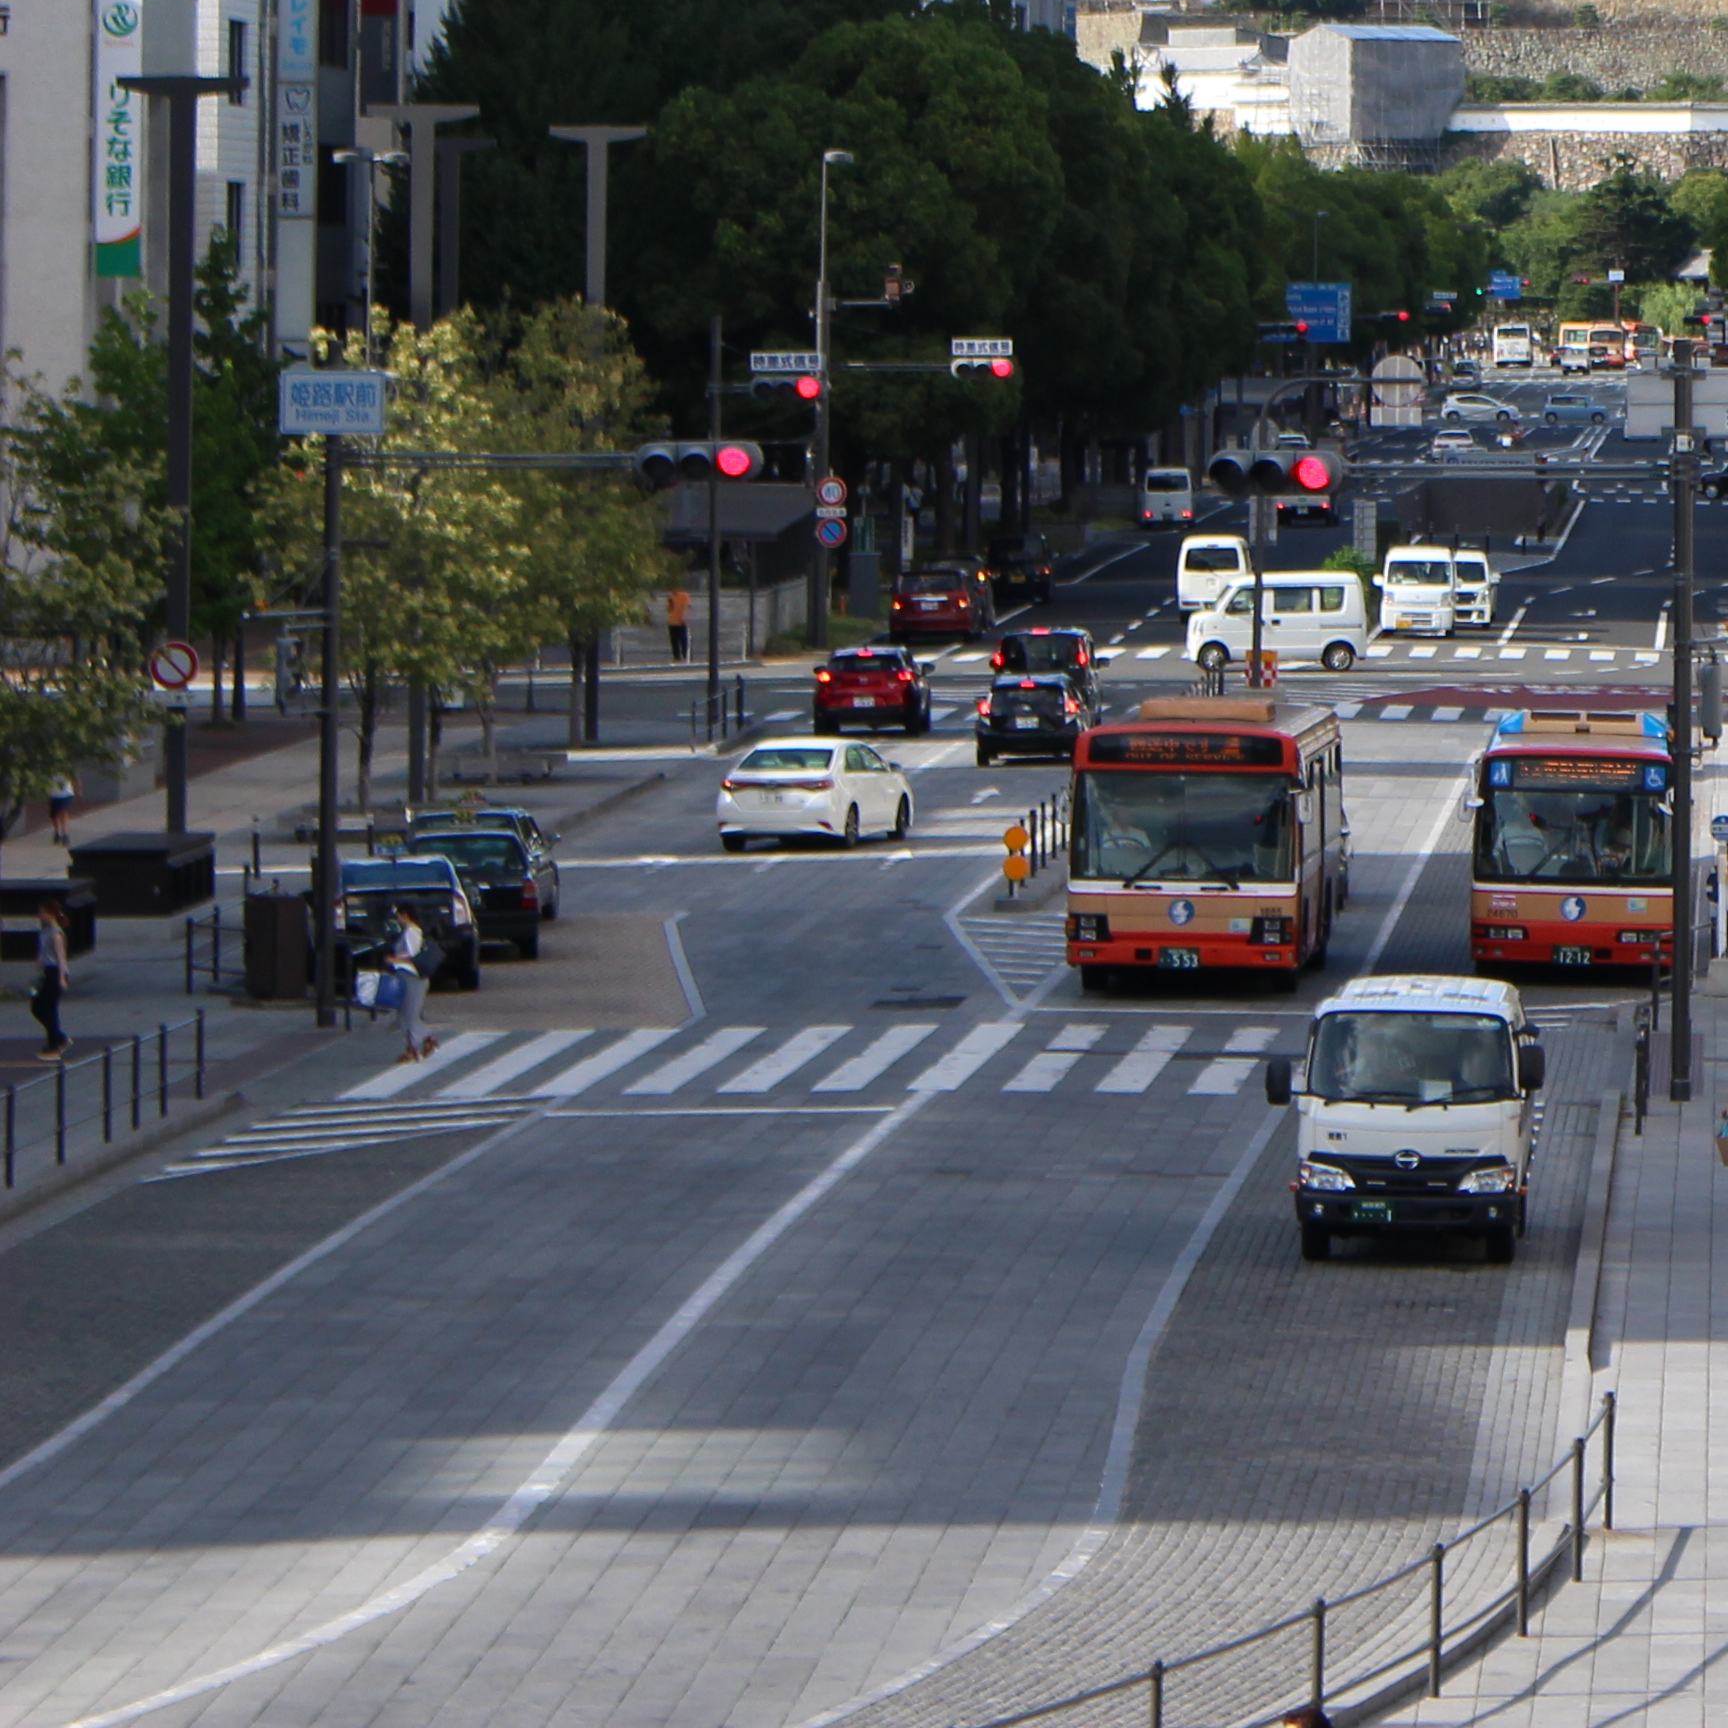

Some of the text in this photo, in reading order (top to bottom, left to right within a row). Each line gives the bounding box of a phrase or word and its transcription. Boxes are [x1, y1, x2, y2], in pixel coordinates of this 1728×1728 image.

[104, 82, 134, 218] りそな銀行
[280, 121, 300, 212] 矯正歯科
[752, 354, 820, 370] 時差式信号
[290, 379, 377, 409] 姫路駅前
[295, 407, 374, 428] Himeji Sta.
